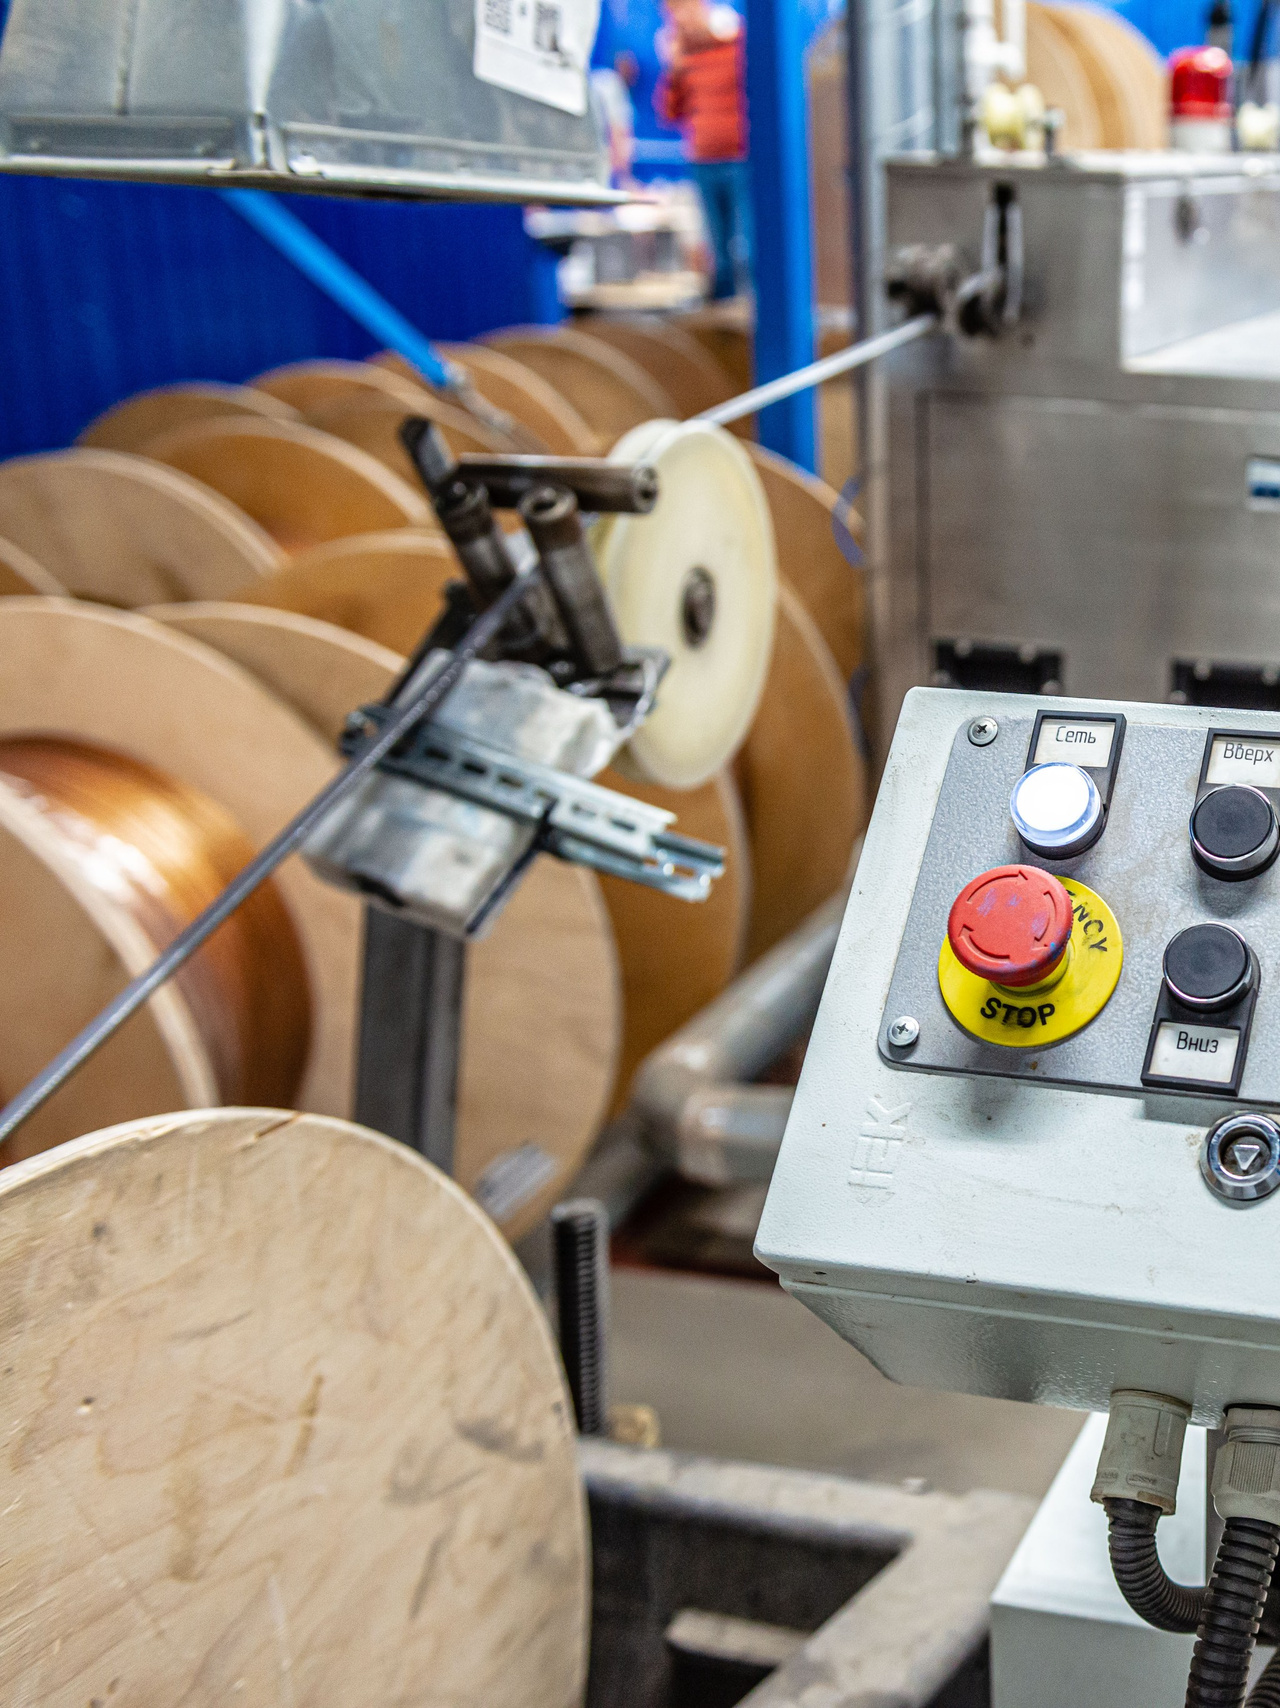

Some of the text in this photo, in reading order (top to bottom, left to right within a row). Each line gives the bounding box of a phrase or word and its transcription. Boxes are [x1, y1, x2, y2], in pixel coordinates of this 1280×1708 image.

[1055, 726, 1097, 745] Сеть
[1223, 742, 1275, 765] Вверх
[1066, 889, 1108, 952] NCY
[980, 997, 1056, 1028] STOP
[1176, 1030, 1219, 1054] Вниз
